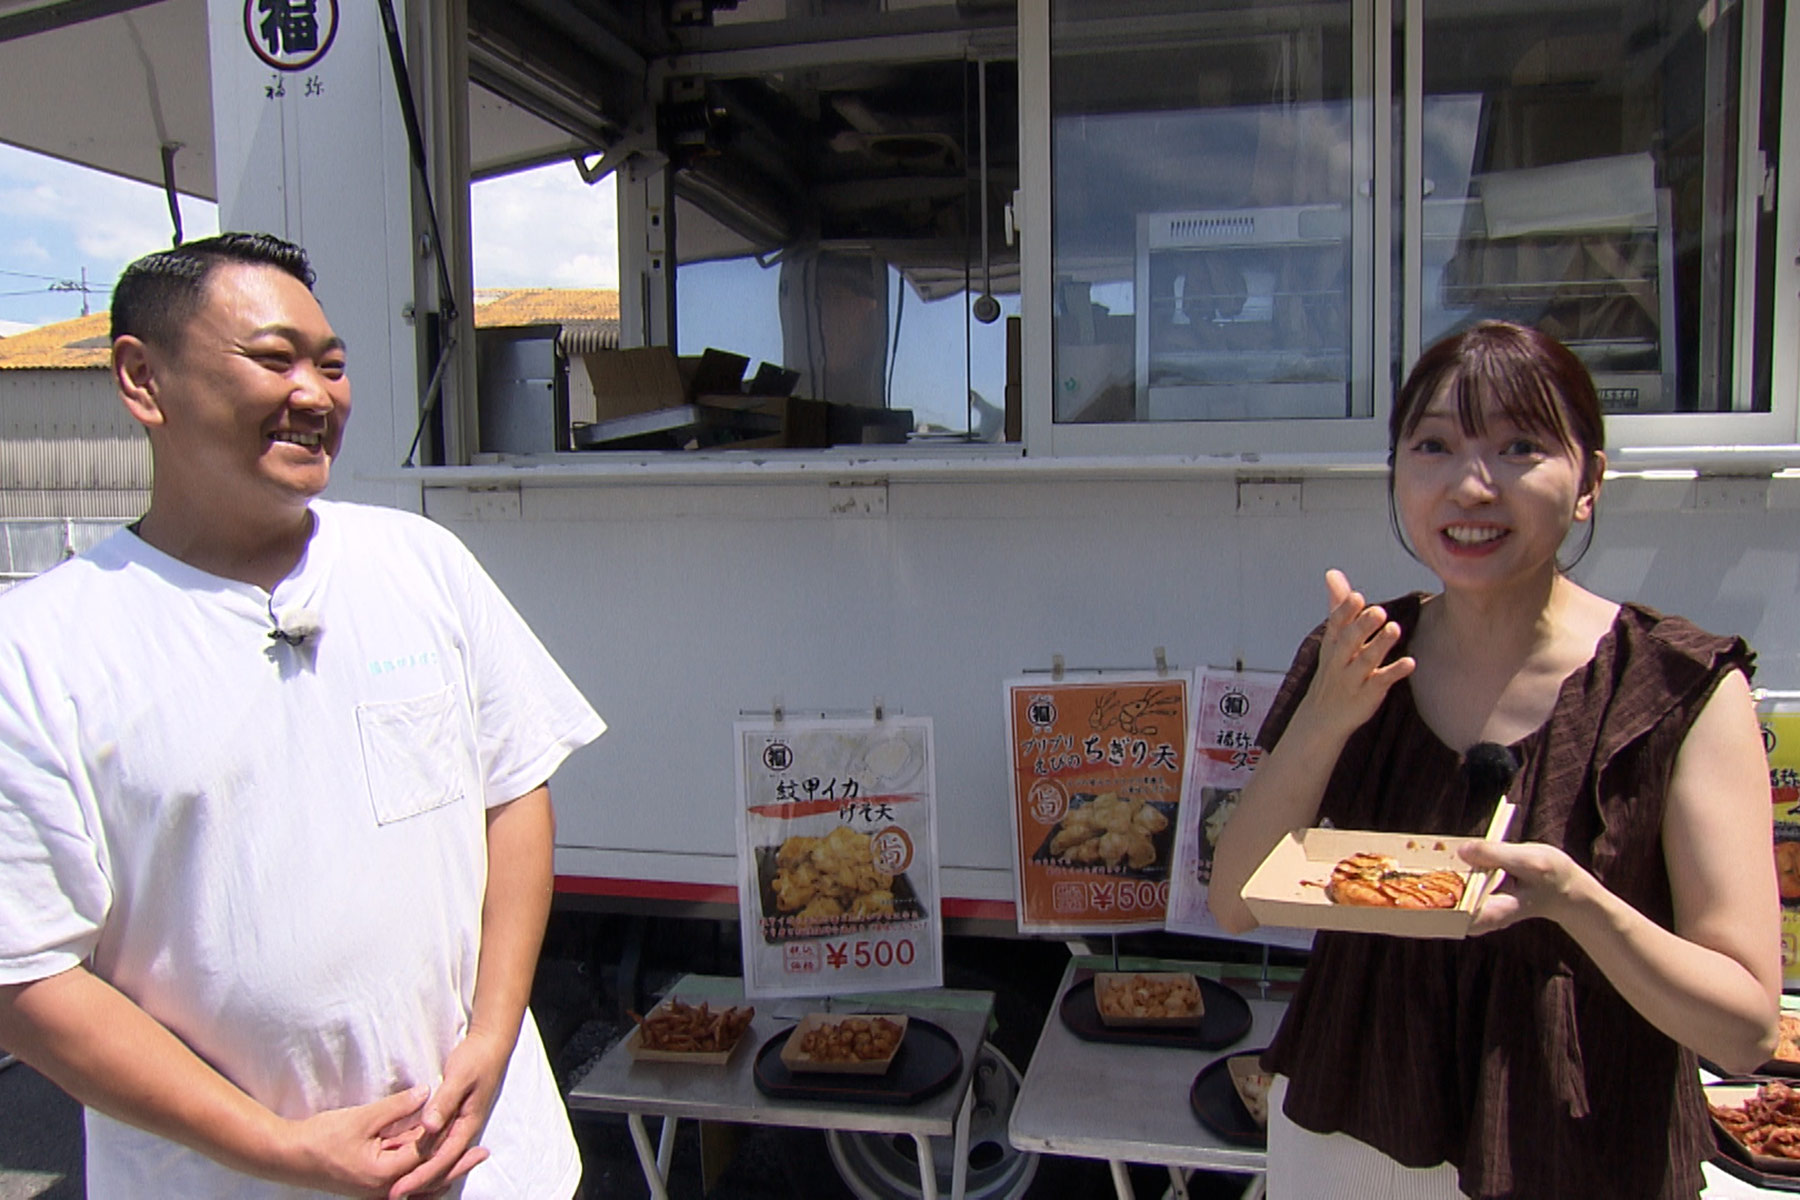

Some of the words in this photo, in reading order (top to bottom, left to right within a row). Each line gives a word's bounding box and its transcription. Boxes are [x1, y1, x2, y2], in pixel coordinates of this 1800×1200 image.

[259, 0, 318, 54] 福
[1035, 756, 1081, 774] えびの
[1083, 736, 1178, 771] ちぎり天
[776, 777, 859, 802] 紋甲イカ
[825, 939, 915, 968] ¥500
